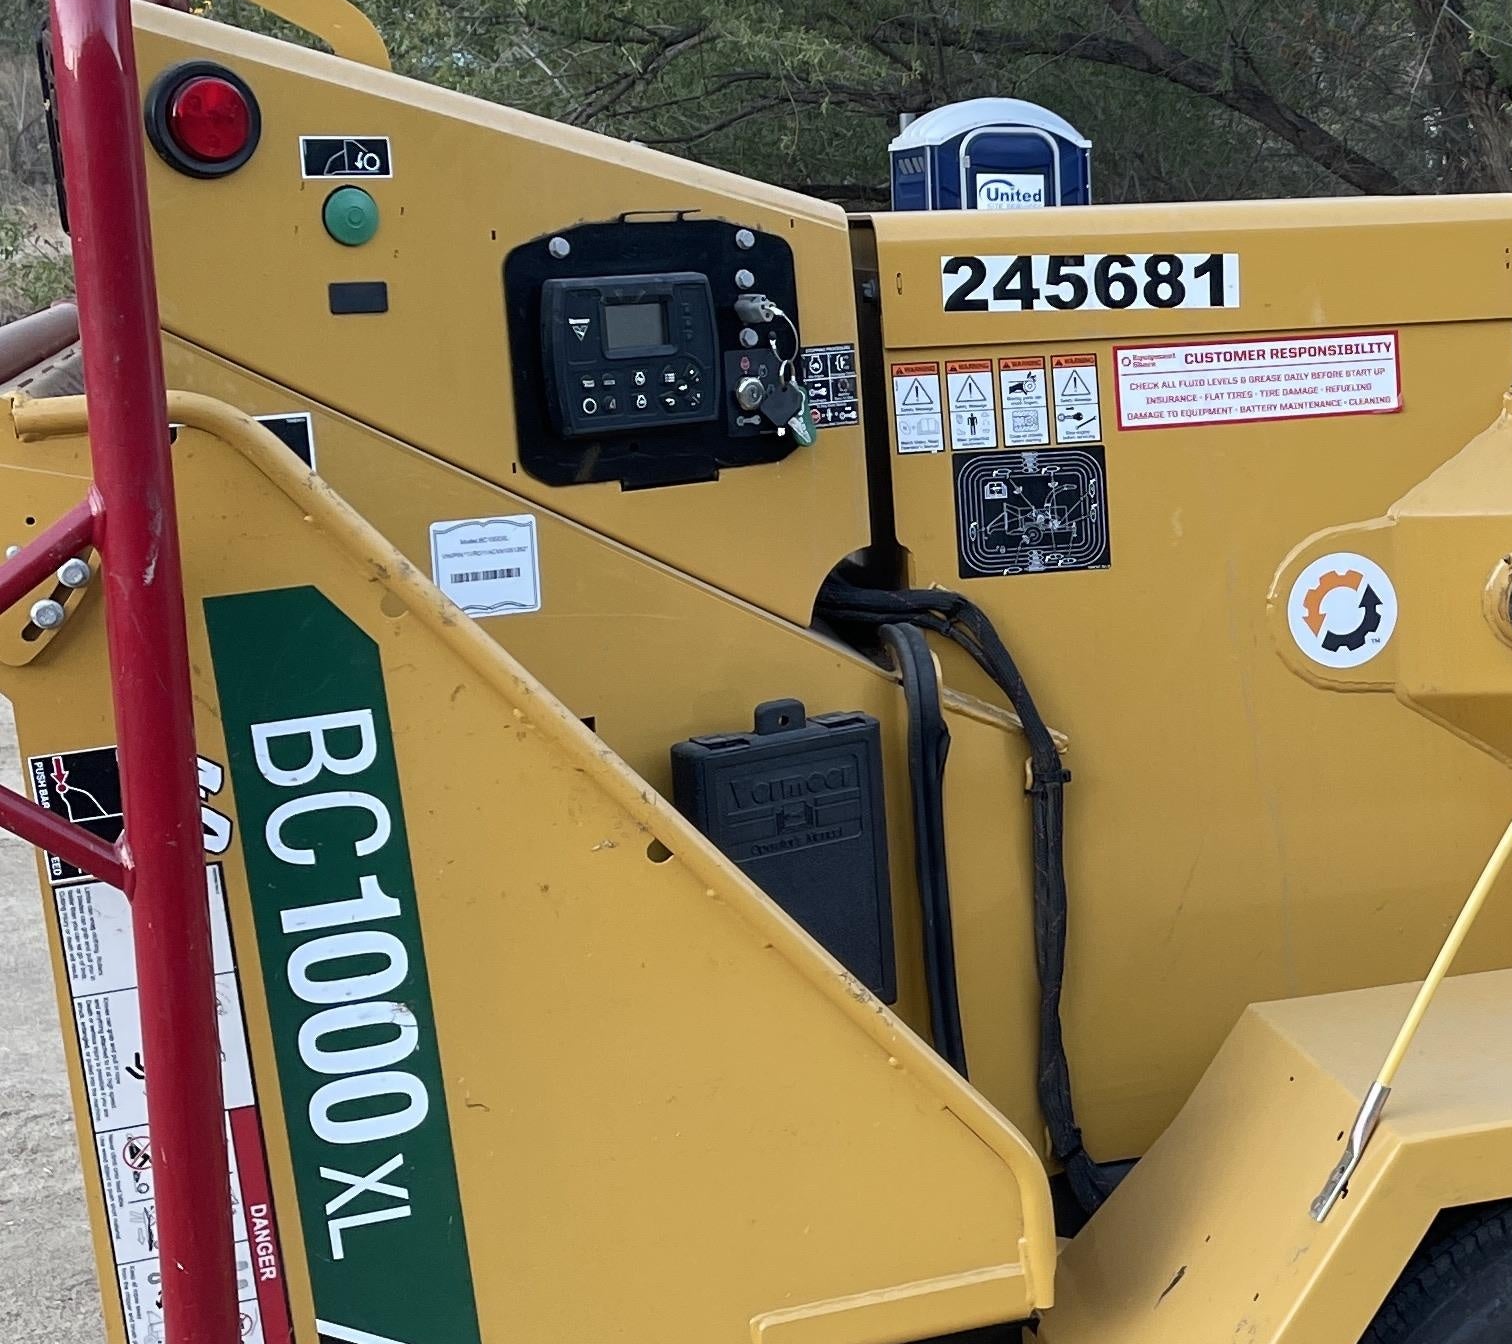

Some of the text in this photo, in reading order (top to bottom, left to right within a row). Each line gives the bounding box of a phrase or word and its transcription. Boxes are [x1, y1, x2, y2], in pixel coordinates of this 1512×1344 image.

[987, 187, 1041, 202] United
[943, 254, 1224, 311] 245681
[1184, 340, 1392, 365] CUSTOMER RESPONSIBILITY
[1129, 381, 1159, 391] CHECK
[1161, 380, 1177, 389] ALL
[1179, 379, 1205, 388] FLUID
[1207, 377, 1239, 386] LEVELS
[1248, 374, 1282, 384] GREASE
[1284, 372, 1309, 382] DAILY
[1311, 370, 1344, 380] BEFORE
[1345, 368, 1373, 378] START
[1374, 367, 1386, 376] UP
[1146, 382, 1372, 405] INSURANCE FLAT TIRES TIRE DAMAGE REFUELING
[1127, 396, 1391, 421] DAMAGE TO EQUIPMENT BATTERY MAINTENANCE CLEANING
[34, 761, 46, 787] PUSH
[250, 1204, 277, 1281] DANGER
